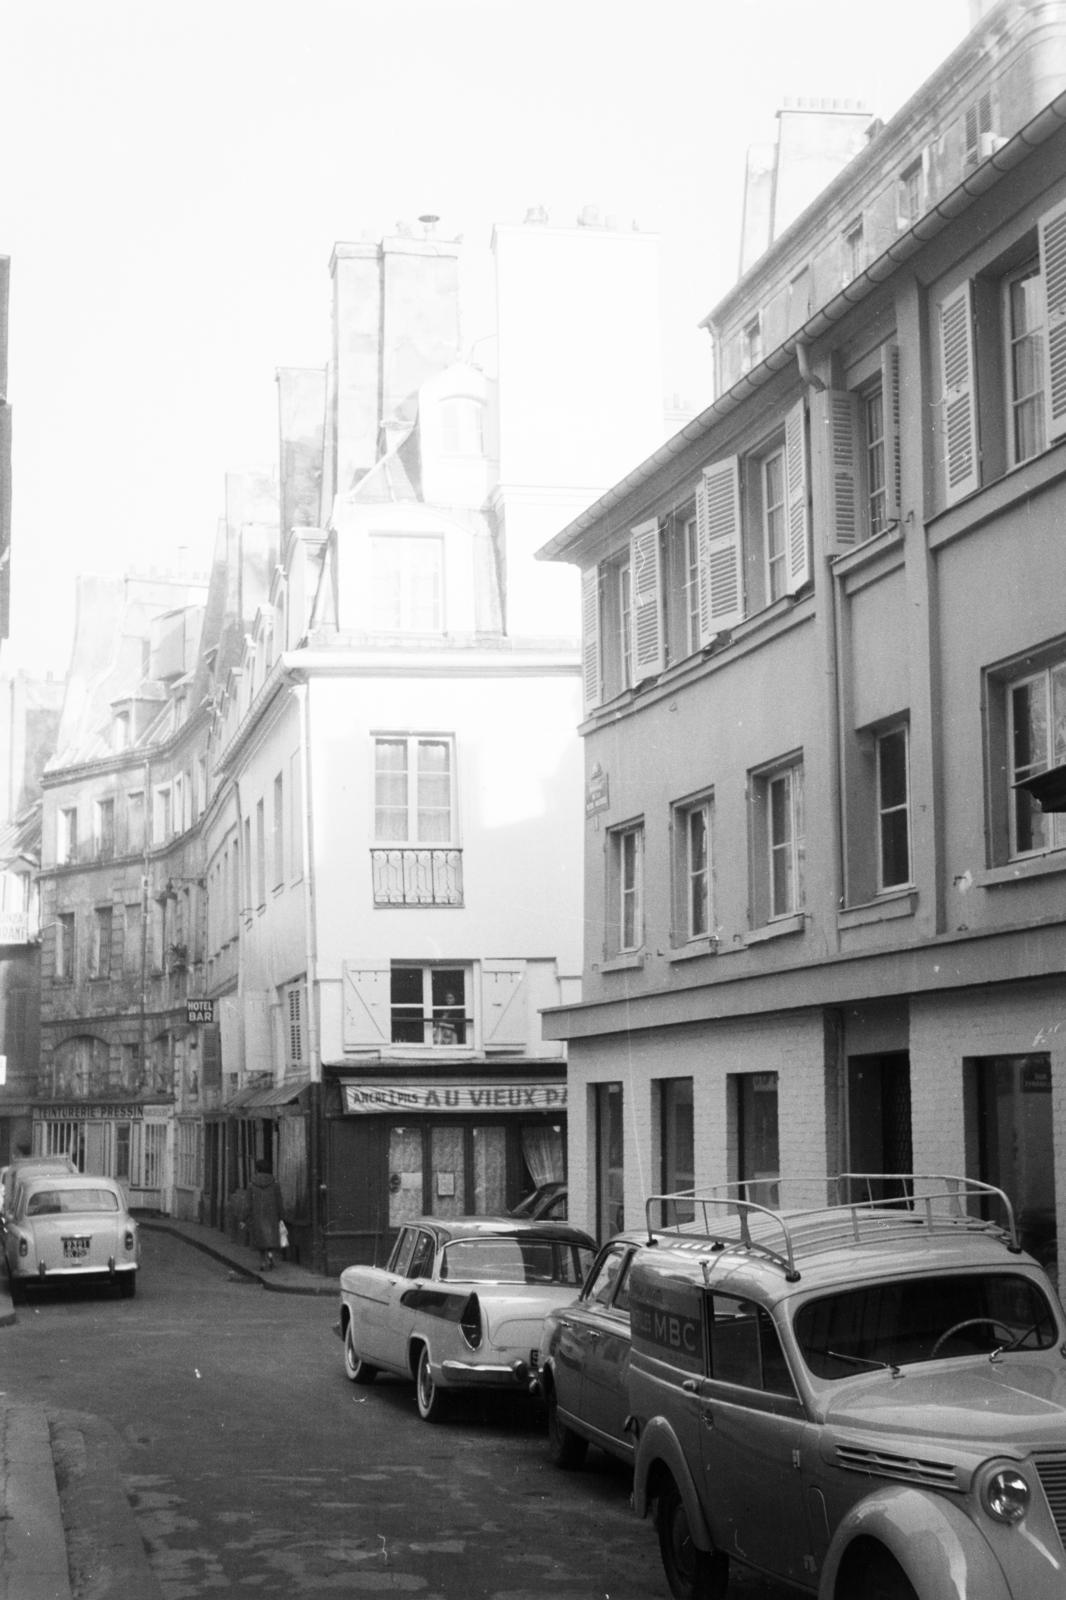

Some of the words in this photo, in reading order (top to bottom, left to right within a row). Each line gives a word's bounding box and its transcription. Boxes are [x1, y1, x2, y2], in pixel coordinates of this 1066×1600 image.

[187, 1001, 212, 1011] HOTEL
[189, 1011, 212, 1022] BAR
[425, 1089, 460, 1107] AU
[469, 1088, 535, 1106] VIEUX
[39, 1105, 96, 1119] TEINTURERIE
[654, 1311, 697, 1352] MBC
